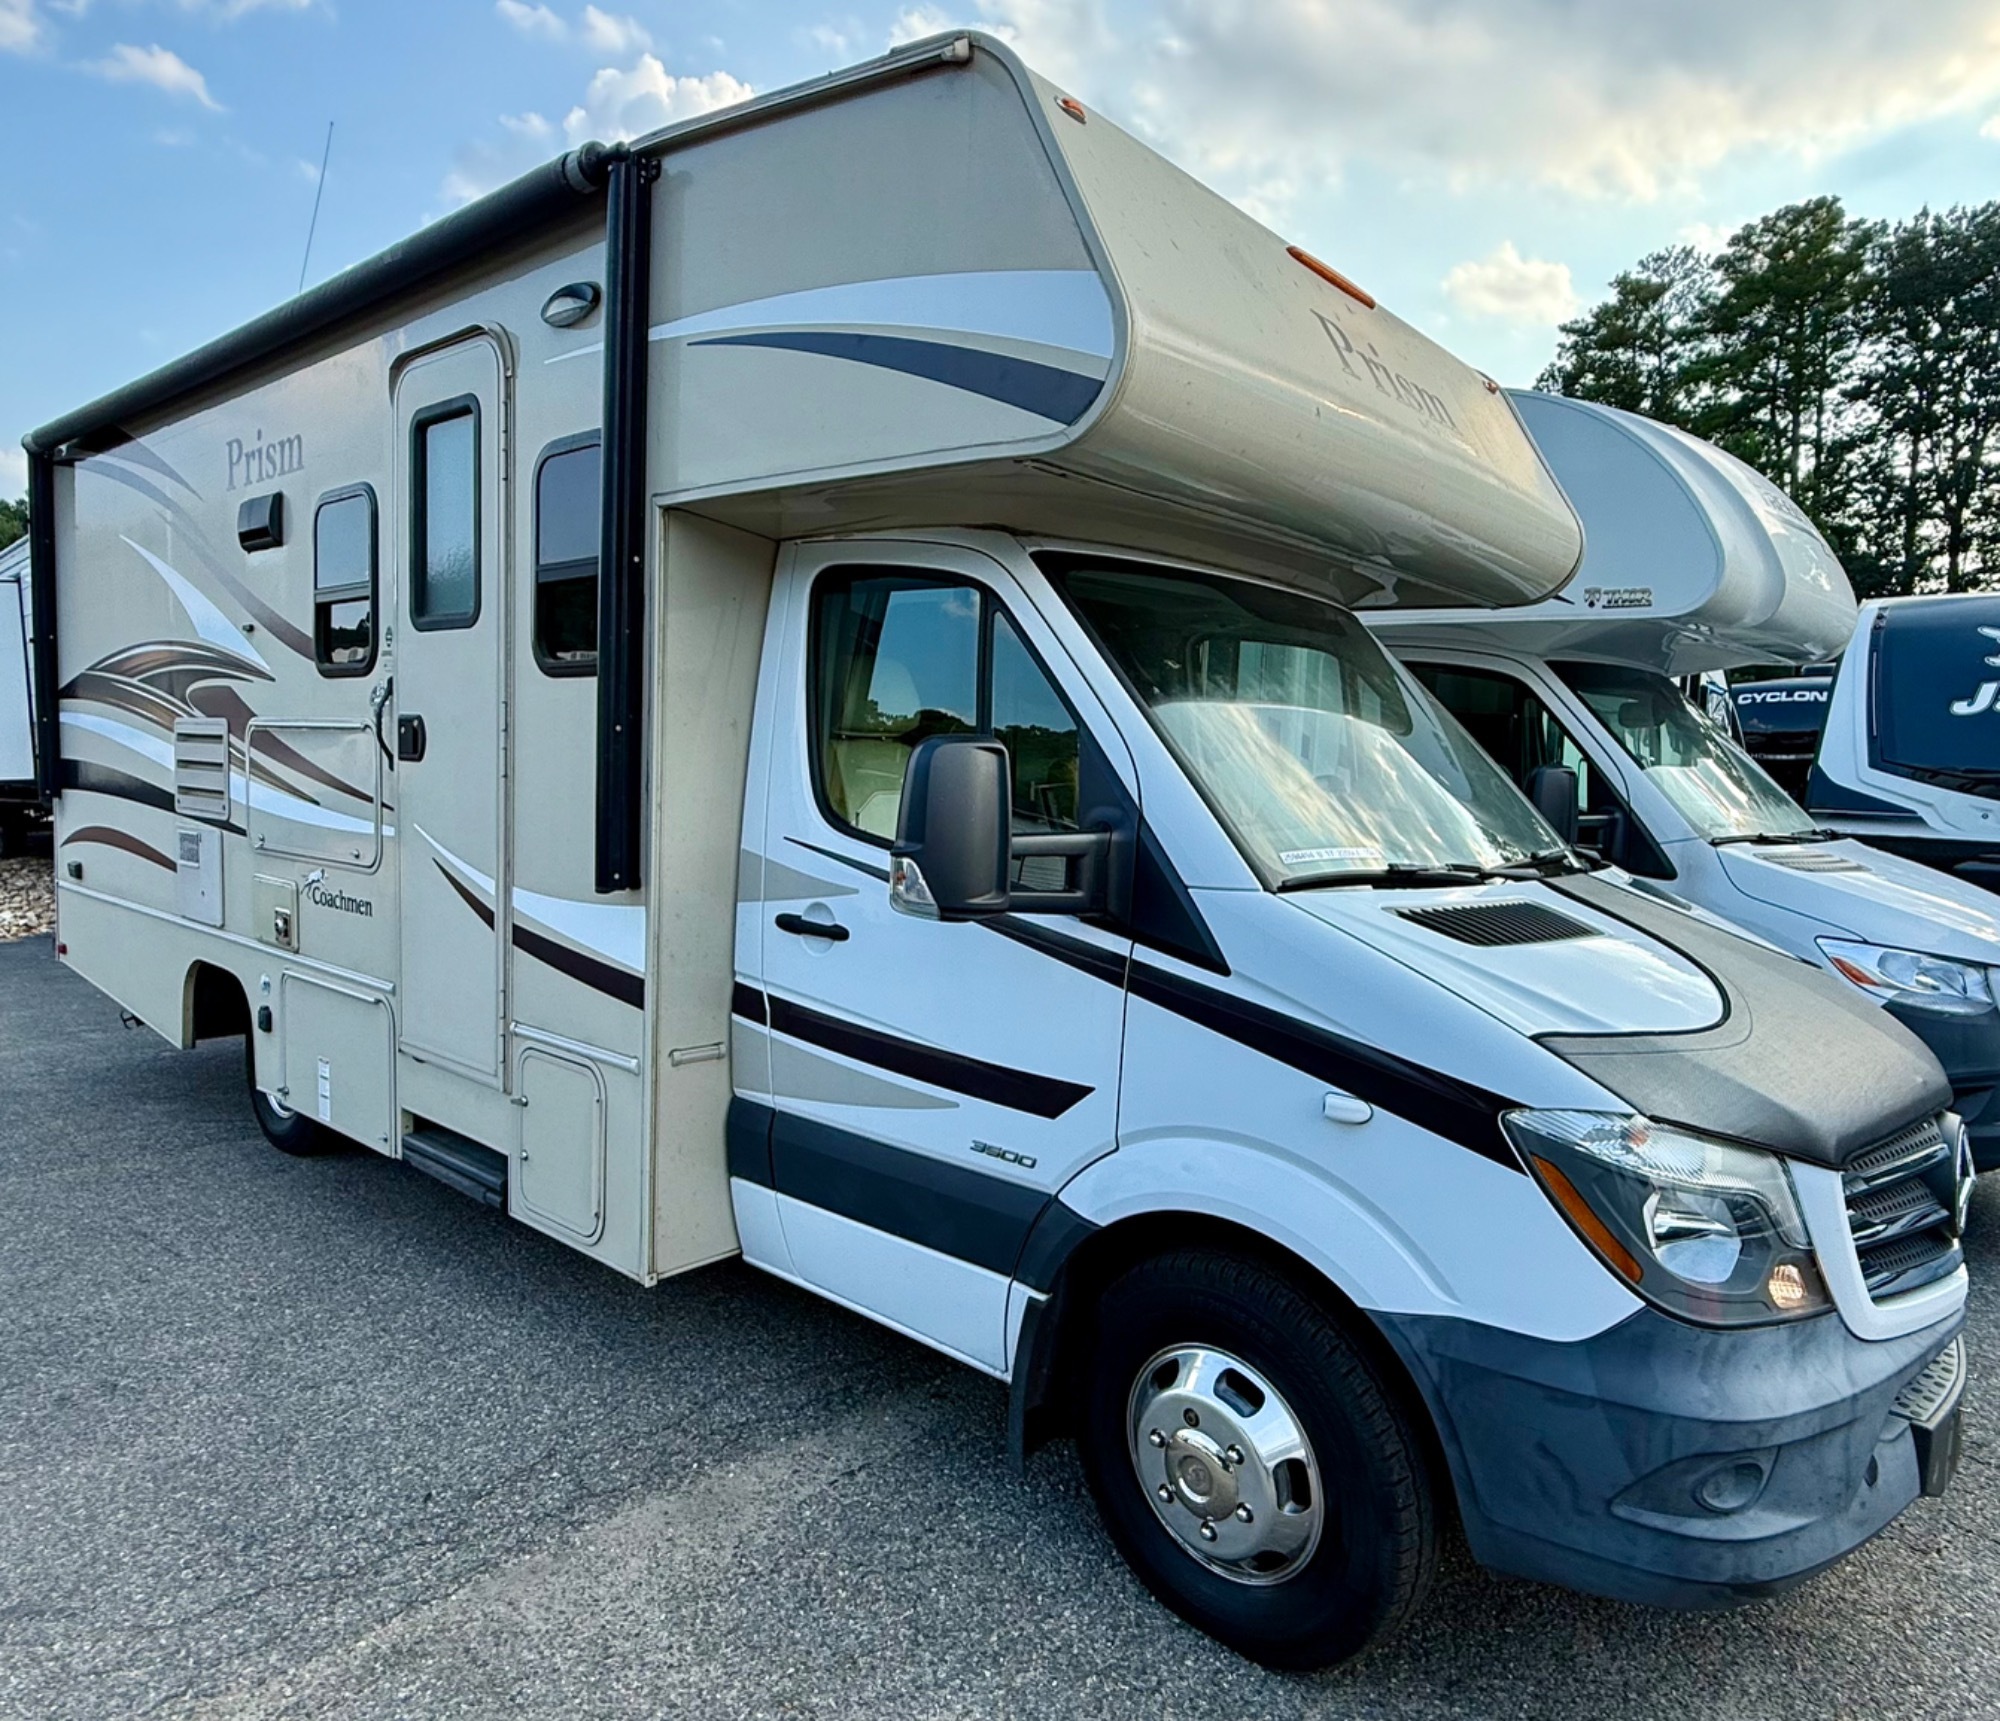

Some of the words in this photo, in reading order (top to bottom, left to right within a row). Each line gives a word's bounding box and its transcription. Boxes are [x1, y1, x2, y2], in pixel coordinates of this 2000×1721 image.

[1310, 308, 1464, 437] Prism
[226, 428, 304, 491] Prism
[1737, 690, 1829, 705] CYCLON
[1950, 681, 2000, 716] J
[312, 886, 373, 917] Coachmen
[969, 1139, 1037, 1169] 3500
